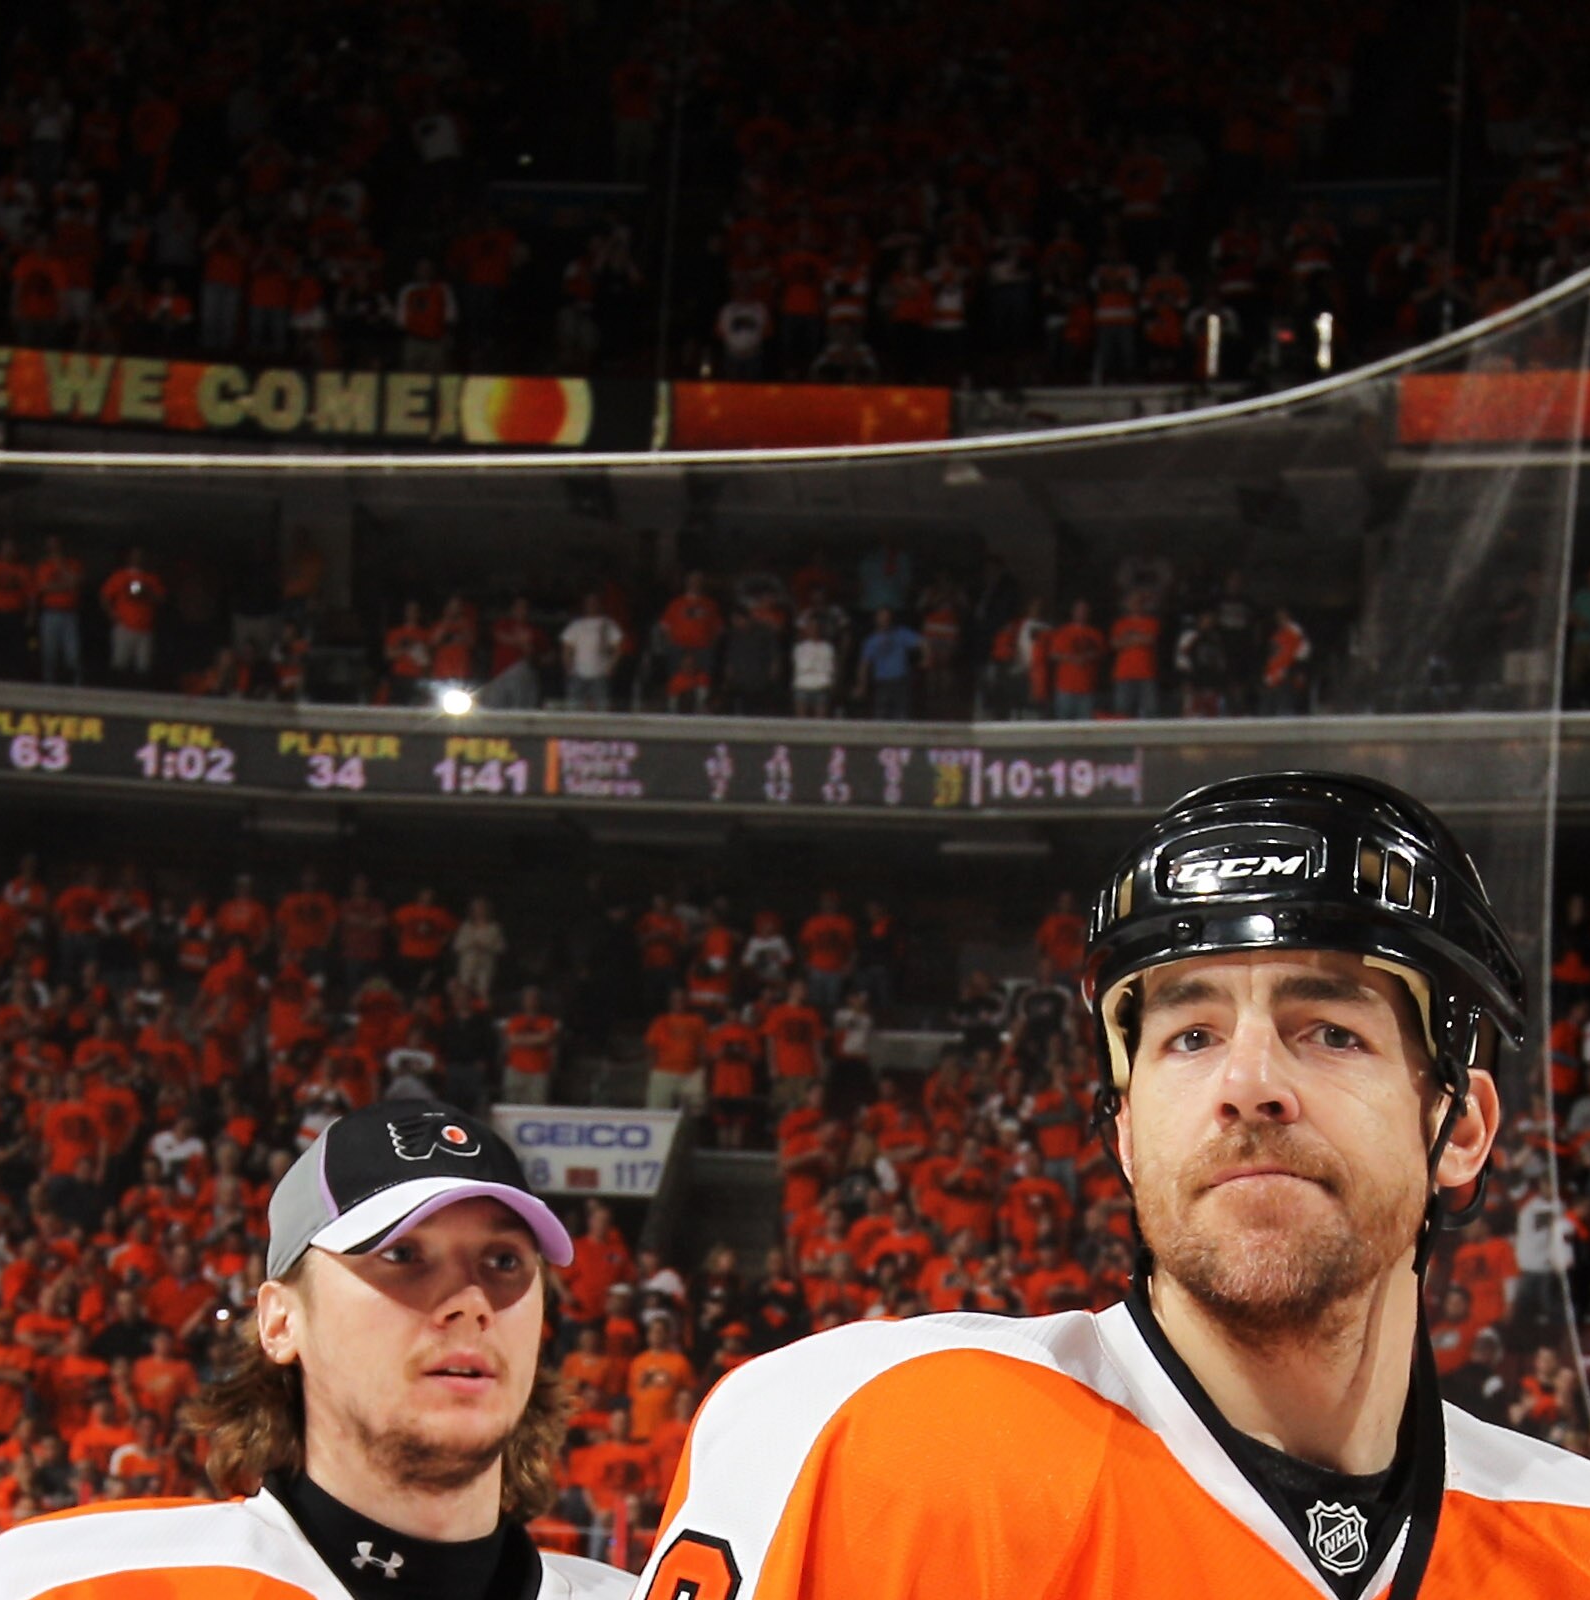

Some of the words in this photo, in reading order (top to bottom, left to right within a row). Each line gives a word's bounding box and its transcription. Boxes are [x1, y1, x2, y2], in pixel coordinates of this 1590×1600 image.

[42, 347, 169, 420] WE
[11, 736, 70, 771] 63
[279, 731, 400, 760] PLAYER
[139, 745, 235, 782] 1:02
[308, 756, 365, 790] 34
[433, 757, 529, 793] 1:41
[1176, 854, 1306, 883] CCM
[516, 1120, 651, 1149] GEICO
[614, 1160, 660, 1188] 117
[1321, 1518, 1359, 1558] NHL
